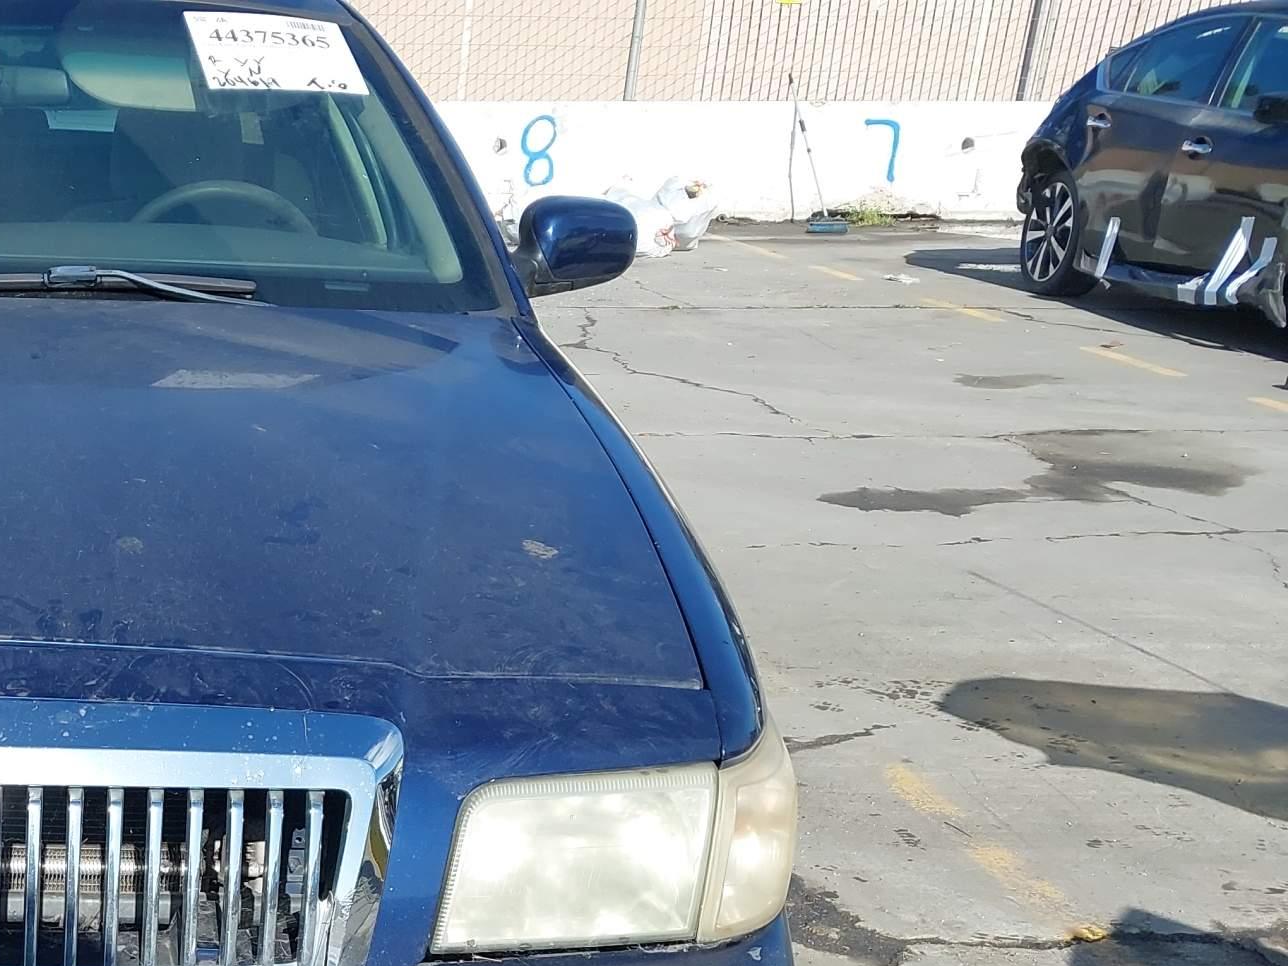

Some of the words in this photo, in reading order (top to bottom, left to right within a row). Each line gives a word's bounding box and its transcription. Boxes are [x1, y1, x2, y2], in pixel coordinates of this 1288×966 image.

[209, 29, 331, 49] 44375365
[521, 114, 557, 187] 8
[864, 118, 900, 183] 7
